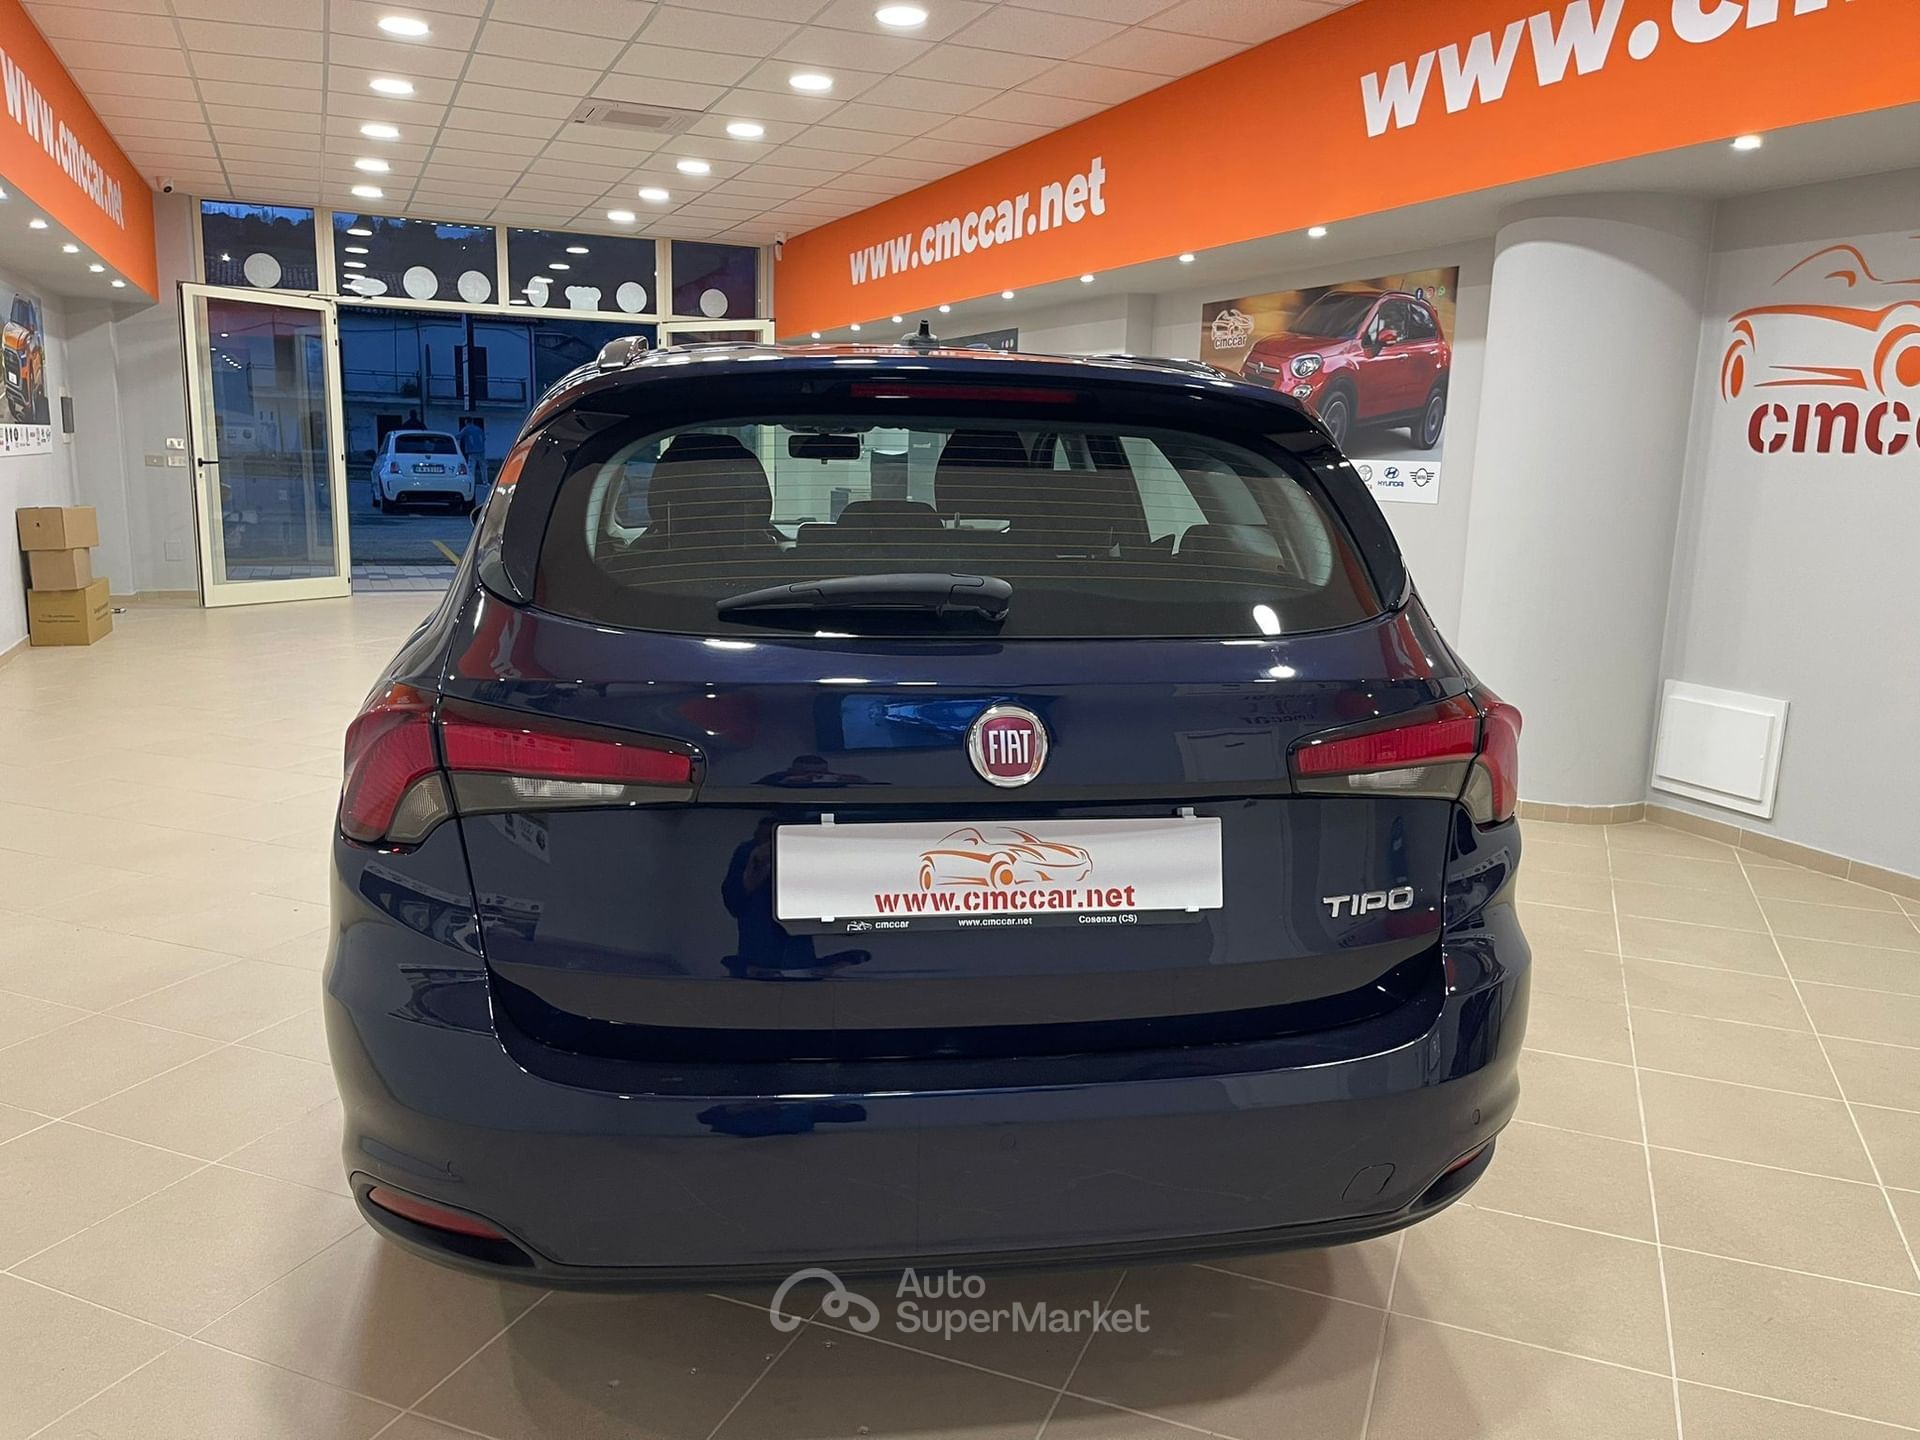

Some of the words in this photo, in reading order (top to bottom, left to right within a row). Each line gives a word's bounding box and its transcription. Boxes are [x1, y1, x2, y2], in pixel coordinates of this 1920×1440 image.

[1360, 0, 1856, 137] www.c
[0, 46, 125, 230] www.cmccar.net
[849, 156, 1106, 286] www.cmccar.net
[1748, 401, 1920, 455] cmc
[988, 729, 1032, 765] FIAT
[874, 884, 1135, 913] www.cmccar.net
[1323, 886, 1414, 918] TIPO
[875, 920, 910, 929] cmccar
[958, 917, 1033, 926] www.cmccar.net
[1078, 914, 1117, 923] Cosenza
[1118, 914, 1138, 923] (CS)
